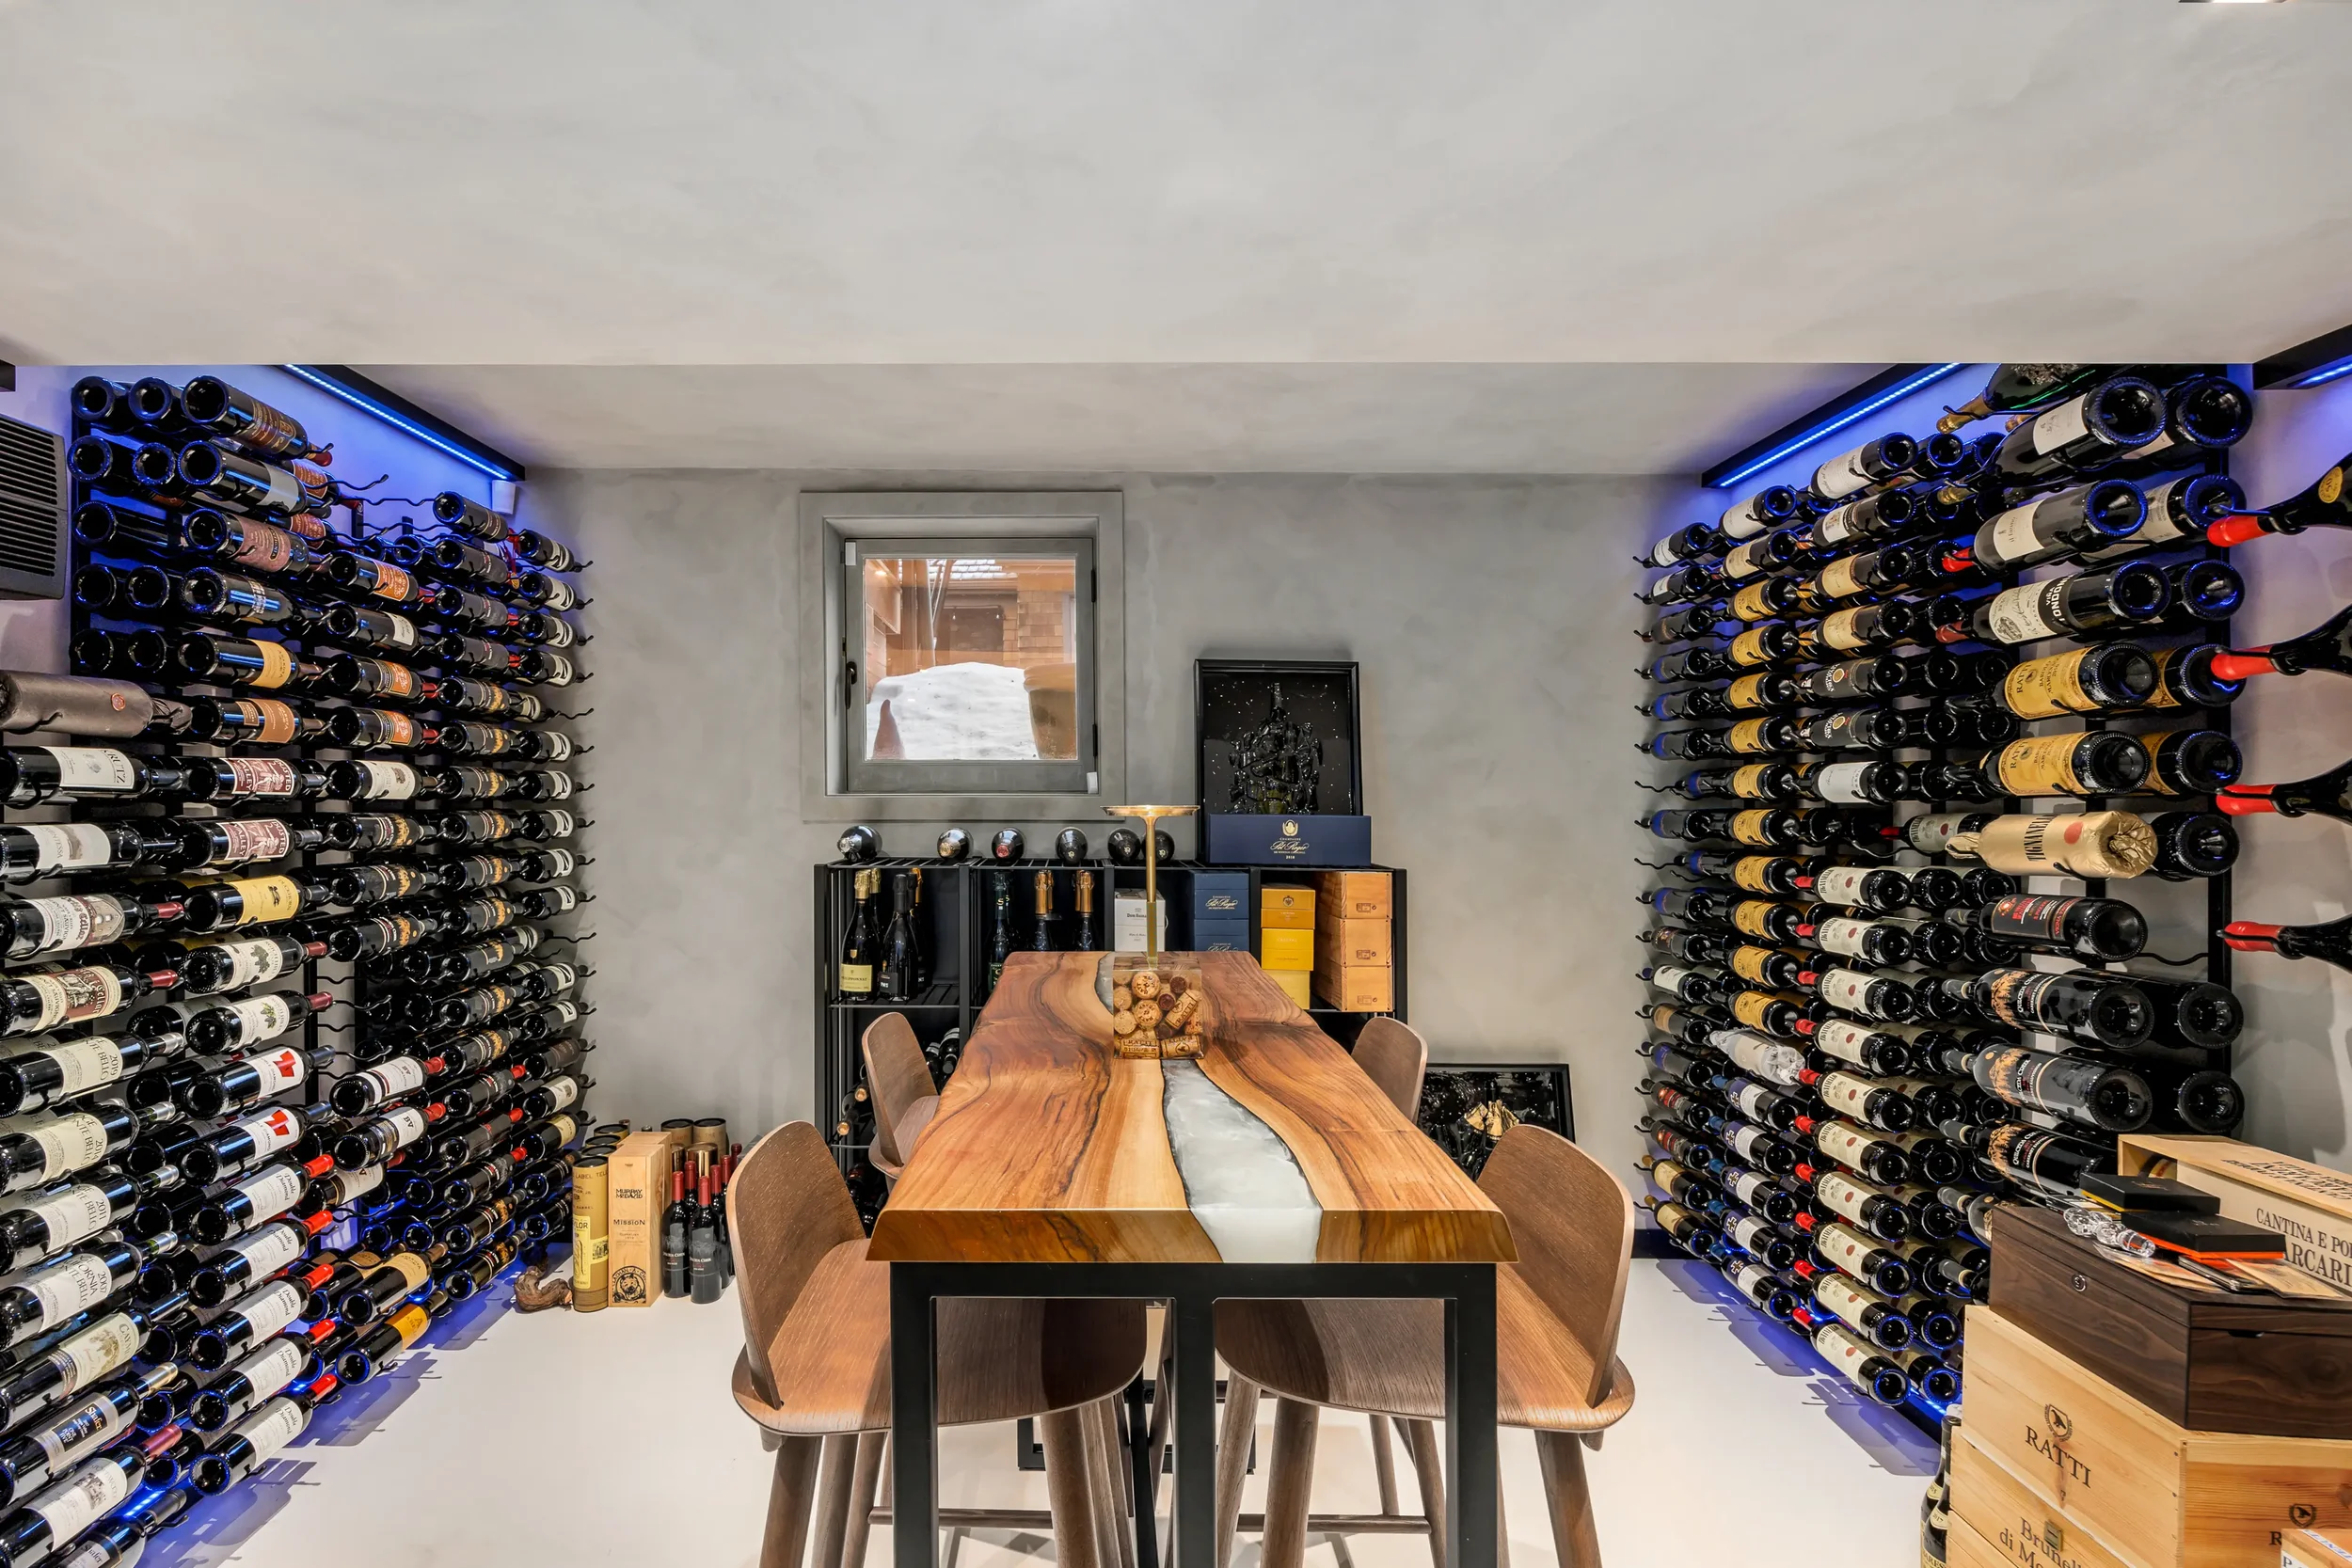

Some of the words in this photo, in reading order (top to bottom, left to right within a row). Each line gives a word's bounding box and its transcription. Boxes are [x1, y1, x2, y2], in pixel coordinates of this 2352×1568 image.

[2045, 587, 2054, 606] VIÑA
[2016, 664, 2031, 693] RATTI
[2010, 740, 2029, 769] RATTI
[103, 750, 126, 784] RUTZ
[274, 759, 292, 791] DUSTED
[271, 821, 285, 854] DUSTED
[996, 897, 1005, 906] S
[1176, 1002, 1194, 1024] RATTI
[98, 1052, 108, 1081] BELLO
[109, 1053, 119, 1077] 2019
[401, 1065, 411, 1075] BV
[2018, 1059, 2031, 1076] CREEK
[404, 1116, 414, 1129] BV
[81, 1136, 96, 1166] BELLO
[2012, 1139, 2026, 1165] QUILCEDA
[276, 1174, 291, 1201] Diamond
[284, 1172, 296, 1195] Double
[575, 1171, 593, 1180] LABEL
[84, 1201, 98, 1231] BELLO
[95, 1198, 107, 1221] 2011
[266, 1228, 289, 1252] Diamond
[277, 1227, 292, 1245] Double
[2256, 1208, 2314, 1244] CANTINA
[2317, 1230, 2328, 1249] E
[75, 1277, 89, 1309] BELLO
[97, 1271, 108, 1294] 2007
[274, 1290, 291, 1317] Diamond
[282, 1287, 296, 1309] Double
[276, 1349, 291, 1377] Diamond
[285, 1347, 296, 1370] Double
[85, 1406, 103, 1431] Shafer
[275, 1407, 292, 1435] Diamond
[284, 1405, 297, 1427] Double
[2025, 1424, 2091, 1489] RATTI
[1999, 1528, 2014, 1552] di
[82, 1544, 103, 1563] Shafer
